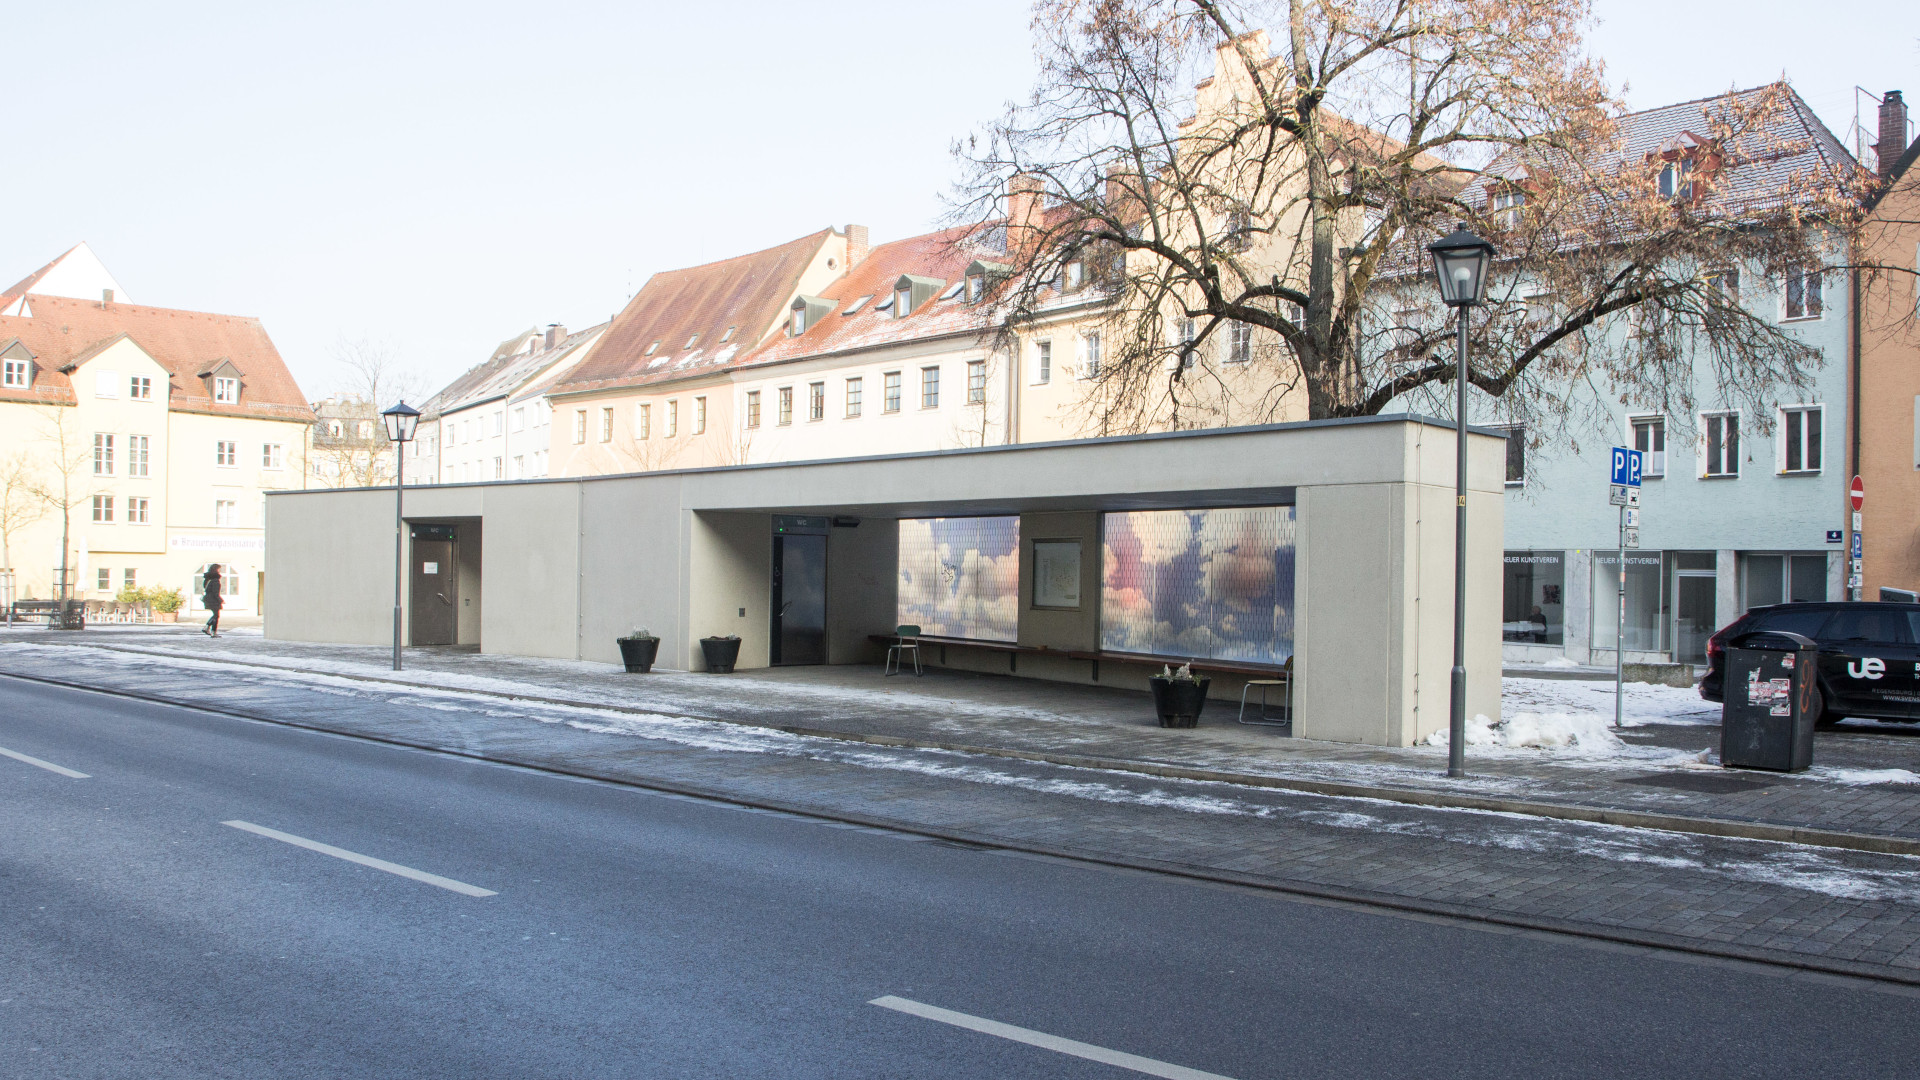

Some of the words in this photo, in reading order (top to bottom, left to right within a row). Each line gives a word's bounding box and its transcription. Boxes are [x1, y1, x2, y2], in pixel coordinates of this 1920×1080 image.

[1614, 451, 1625, 480] P
[1630, 454, 1640, 482] P
[1520, 556, 1559, 564] KUNSTVEREIN
[1617, 557, 1660, 565] KNSTVEREIN
[1871, 687, 1913, 696] REGENSBURG
